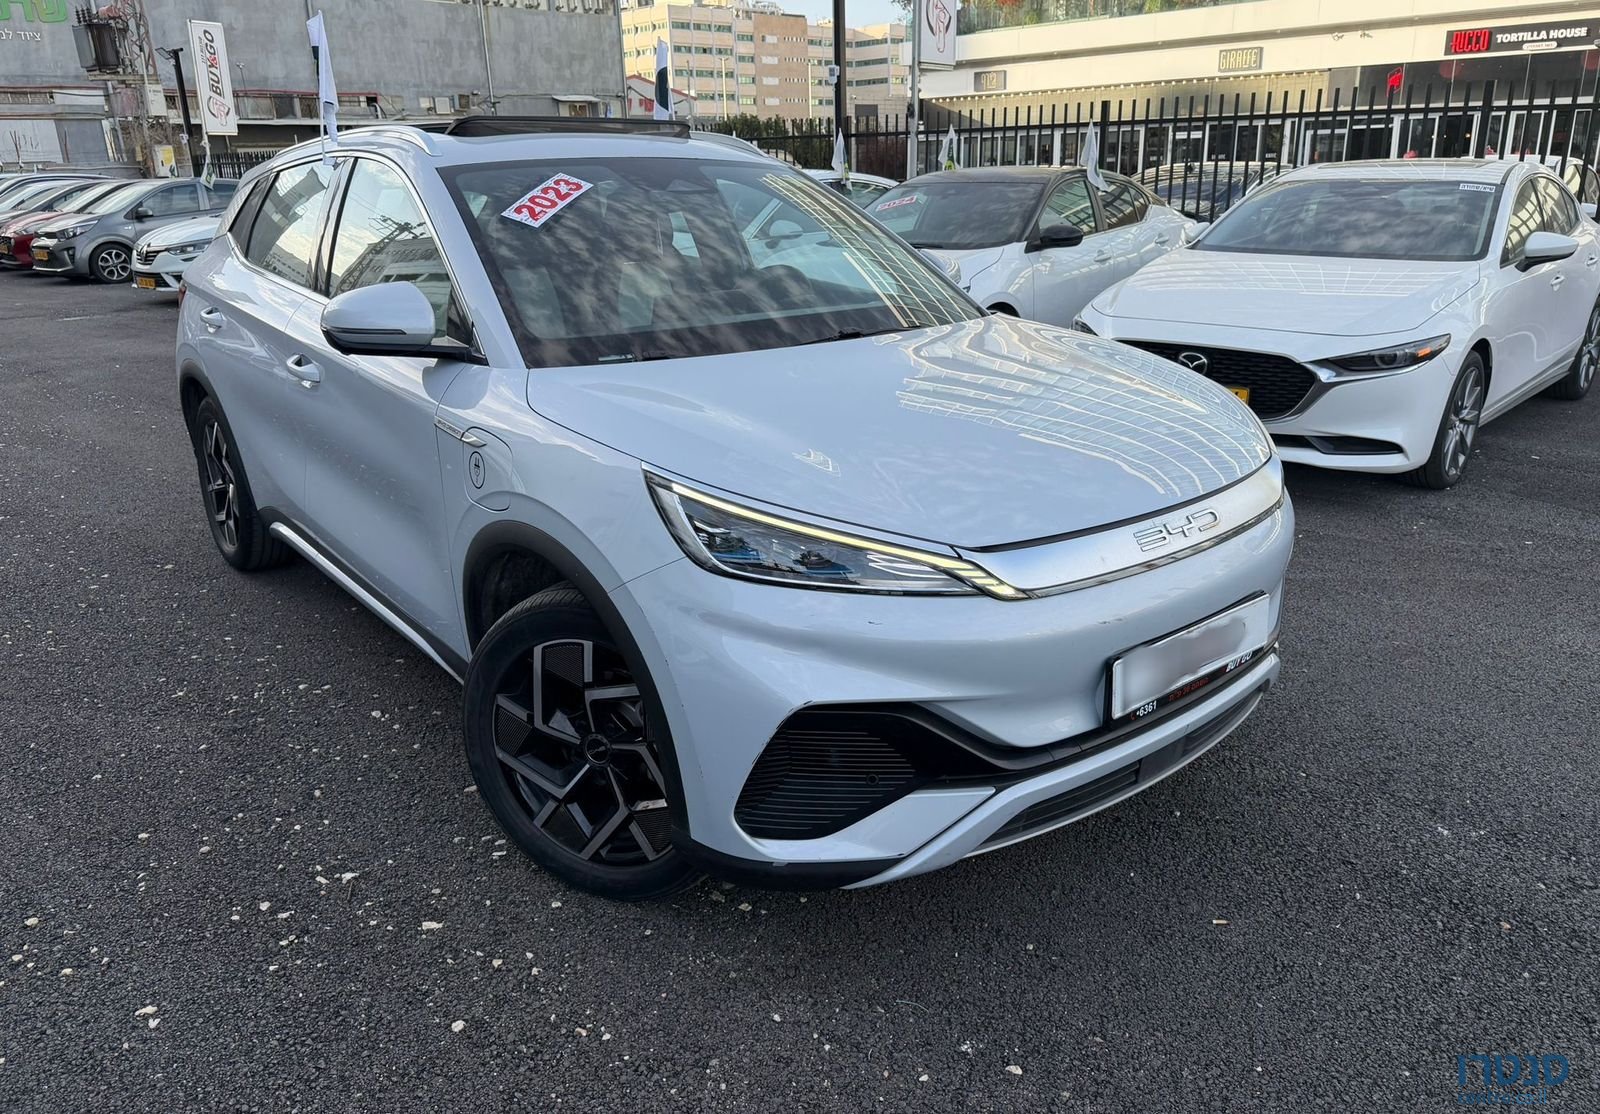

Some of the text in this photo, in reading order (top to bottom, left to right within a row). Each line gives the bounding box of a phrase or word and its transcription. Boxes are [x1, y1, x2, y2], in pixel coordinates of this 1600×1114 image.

[16, 31, 41, 41] ציוד
[1496, 30, 1548, 43] TORTILLA
[1549, 27, 1588, 39] HOUSE
[1220, 49, 1258, 70] GIRAFFE
[513, 178, 584, 222] 2023
[1133, 508, 1221, 552] BYD
